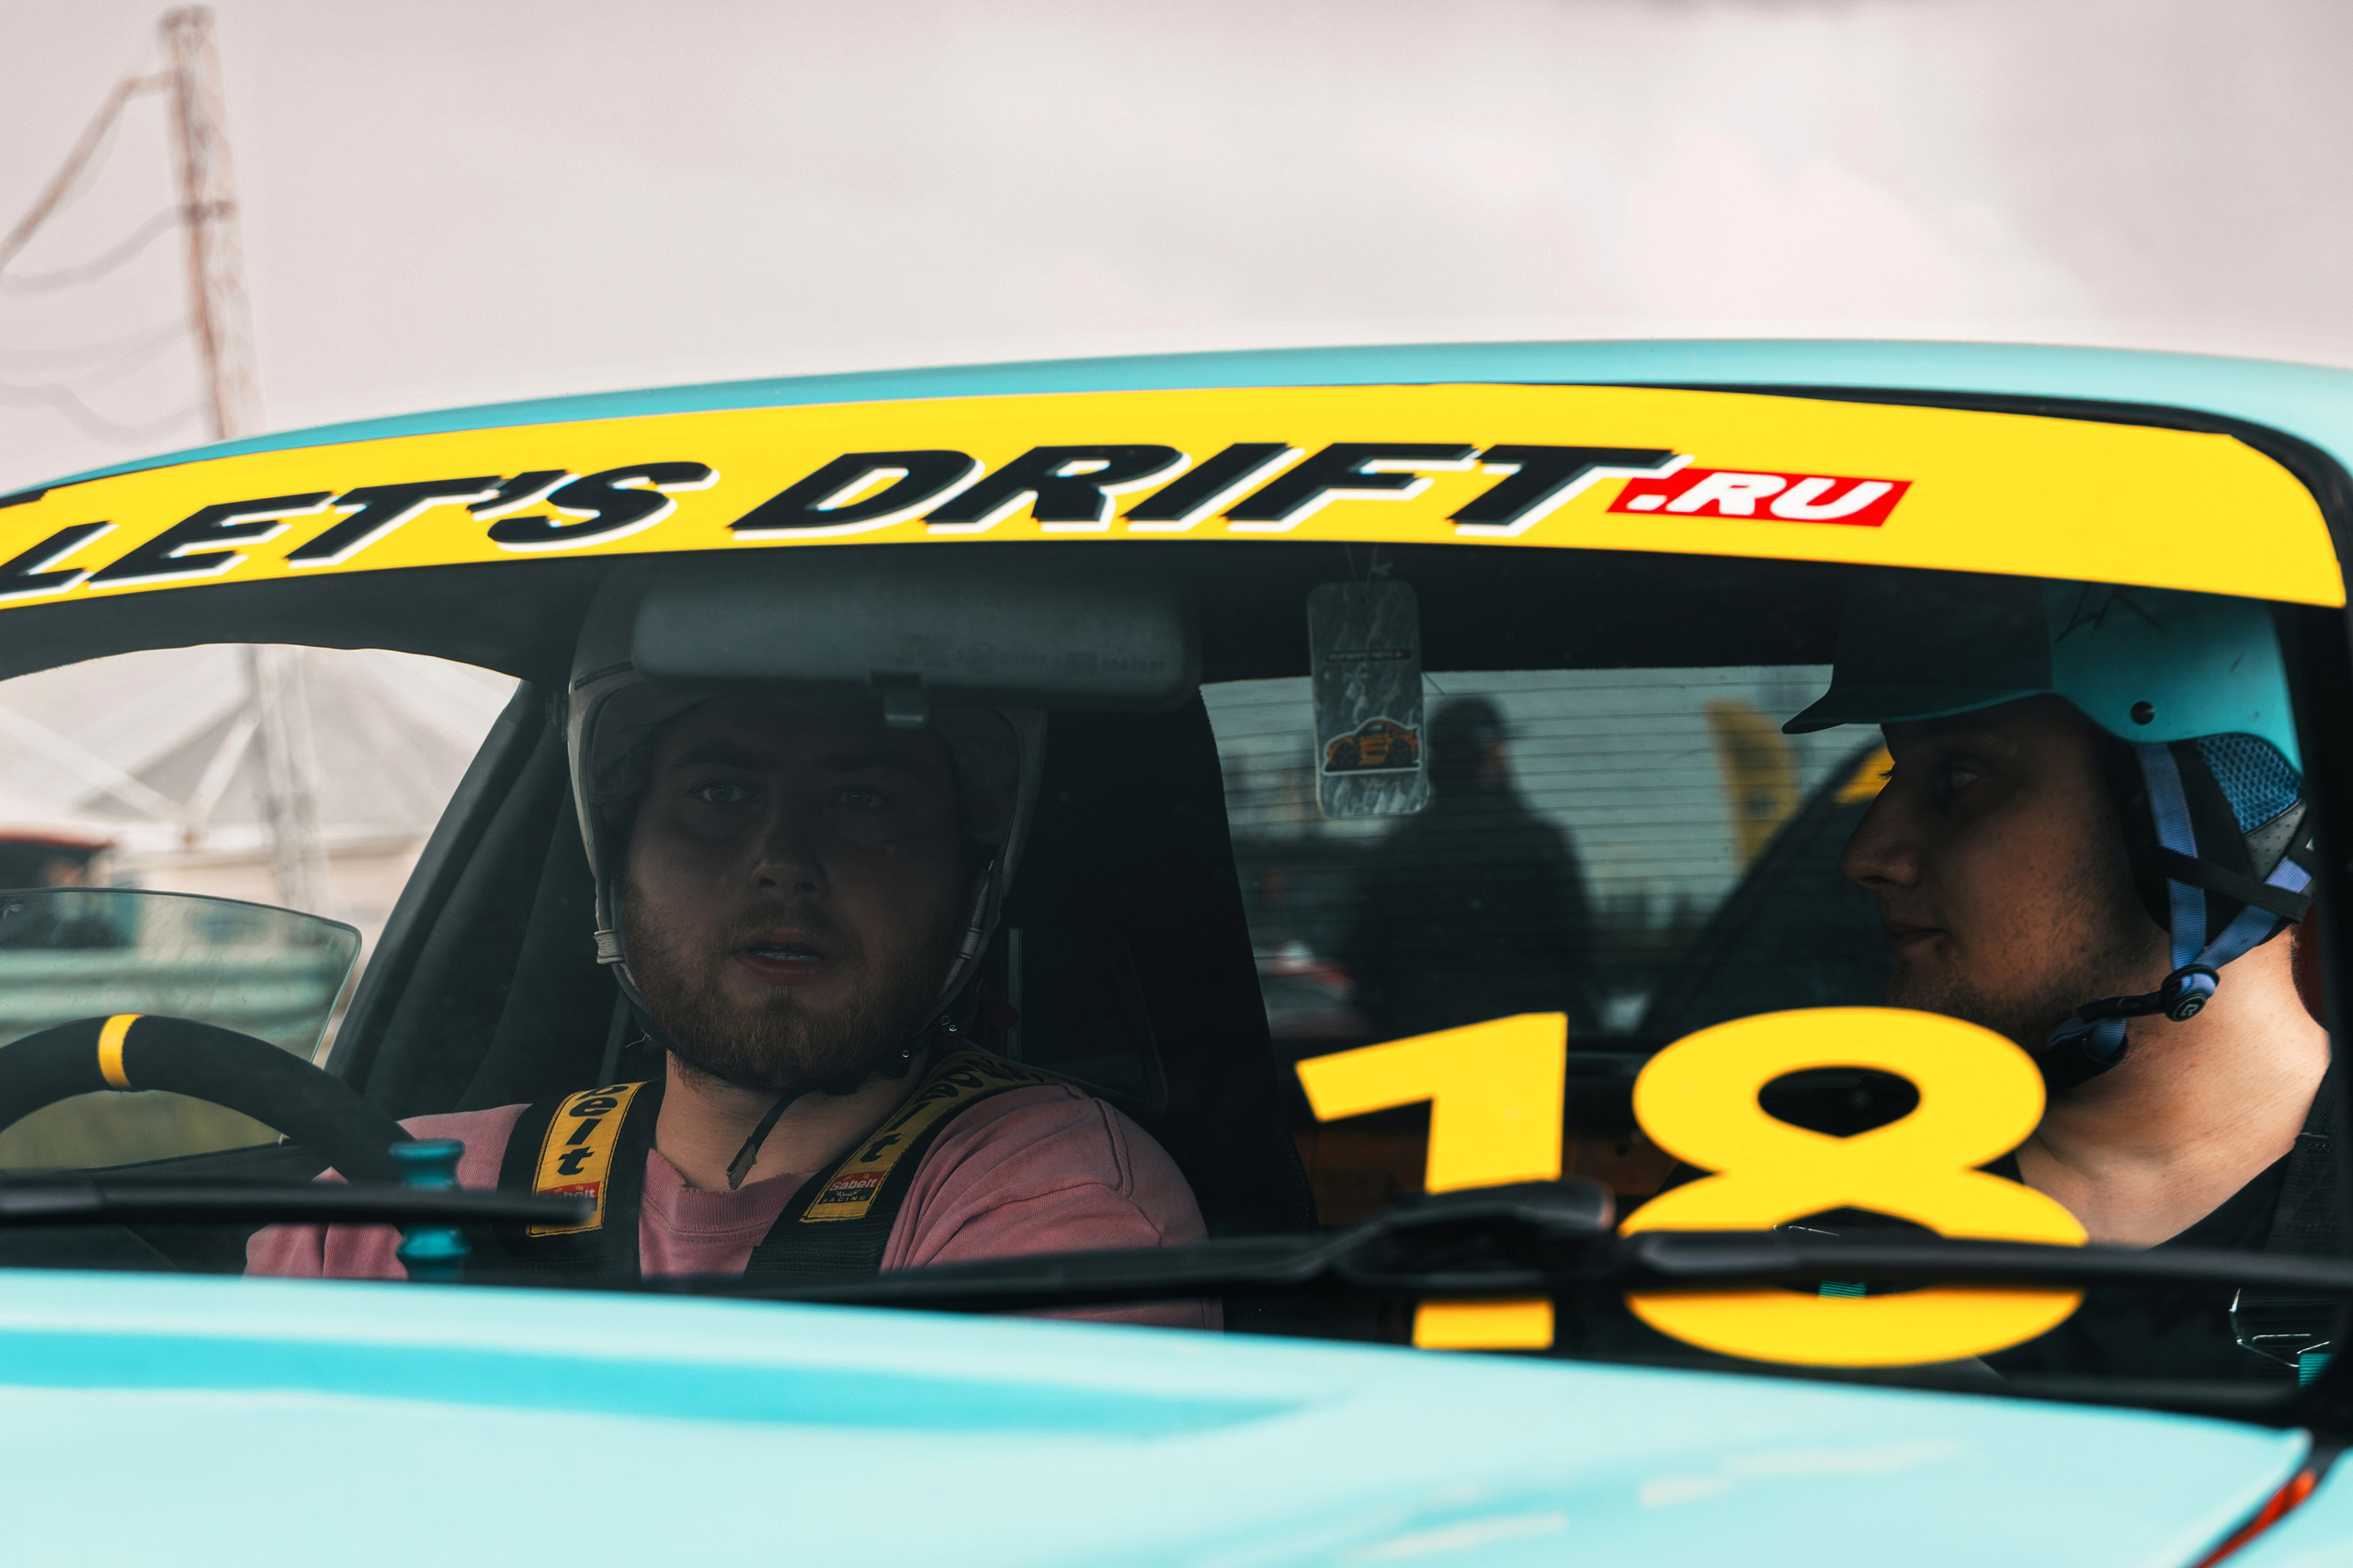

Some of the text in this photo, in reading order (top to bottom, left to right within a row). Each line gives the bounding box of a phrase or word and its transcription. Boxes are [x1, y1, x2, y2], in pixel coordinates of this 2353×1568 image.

[0, 462, 720, 601] LET'S
[829, 1178, 878, 1191] Sabelt
[1296, 1006, 2090, 1367] 18
